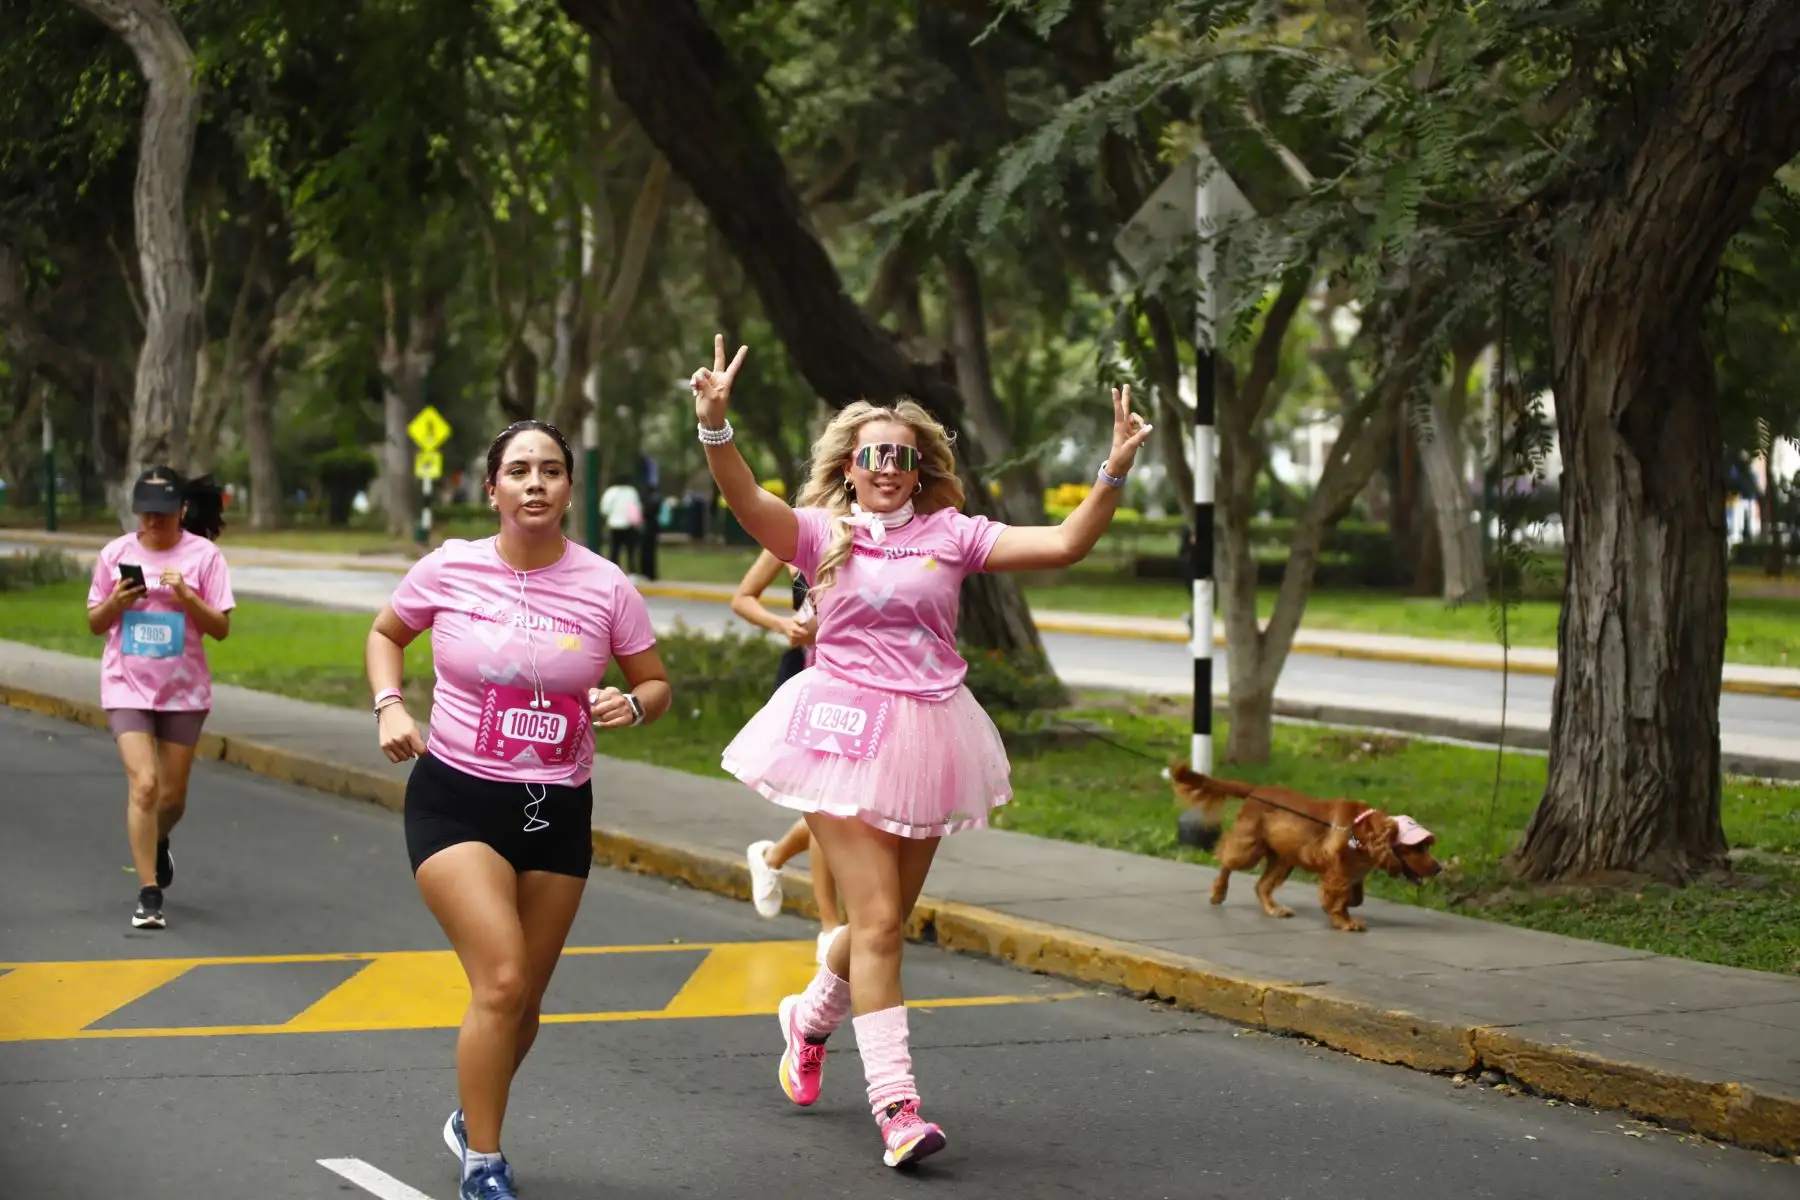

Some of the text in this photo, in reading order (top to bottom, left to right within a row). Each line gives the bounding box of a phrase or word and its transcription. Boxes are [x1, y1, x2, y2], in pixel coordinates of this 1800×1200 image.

[513, 612, 555, 631] RUN
[510, 711, 560, 741] 10059
[816, 706, 861, 732] 12942
